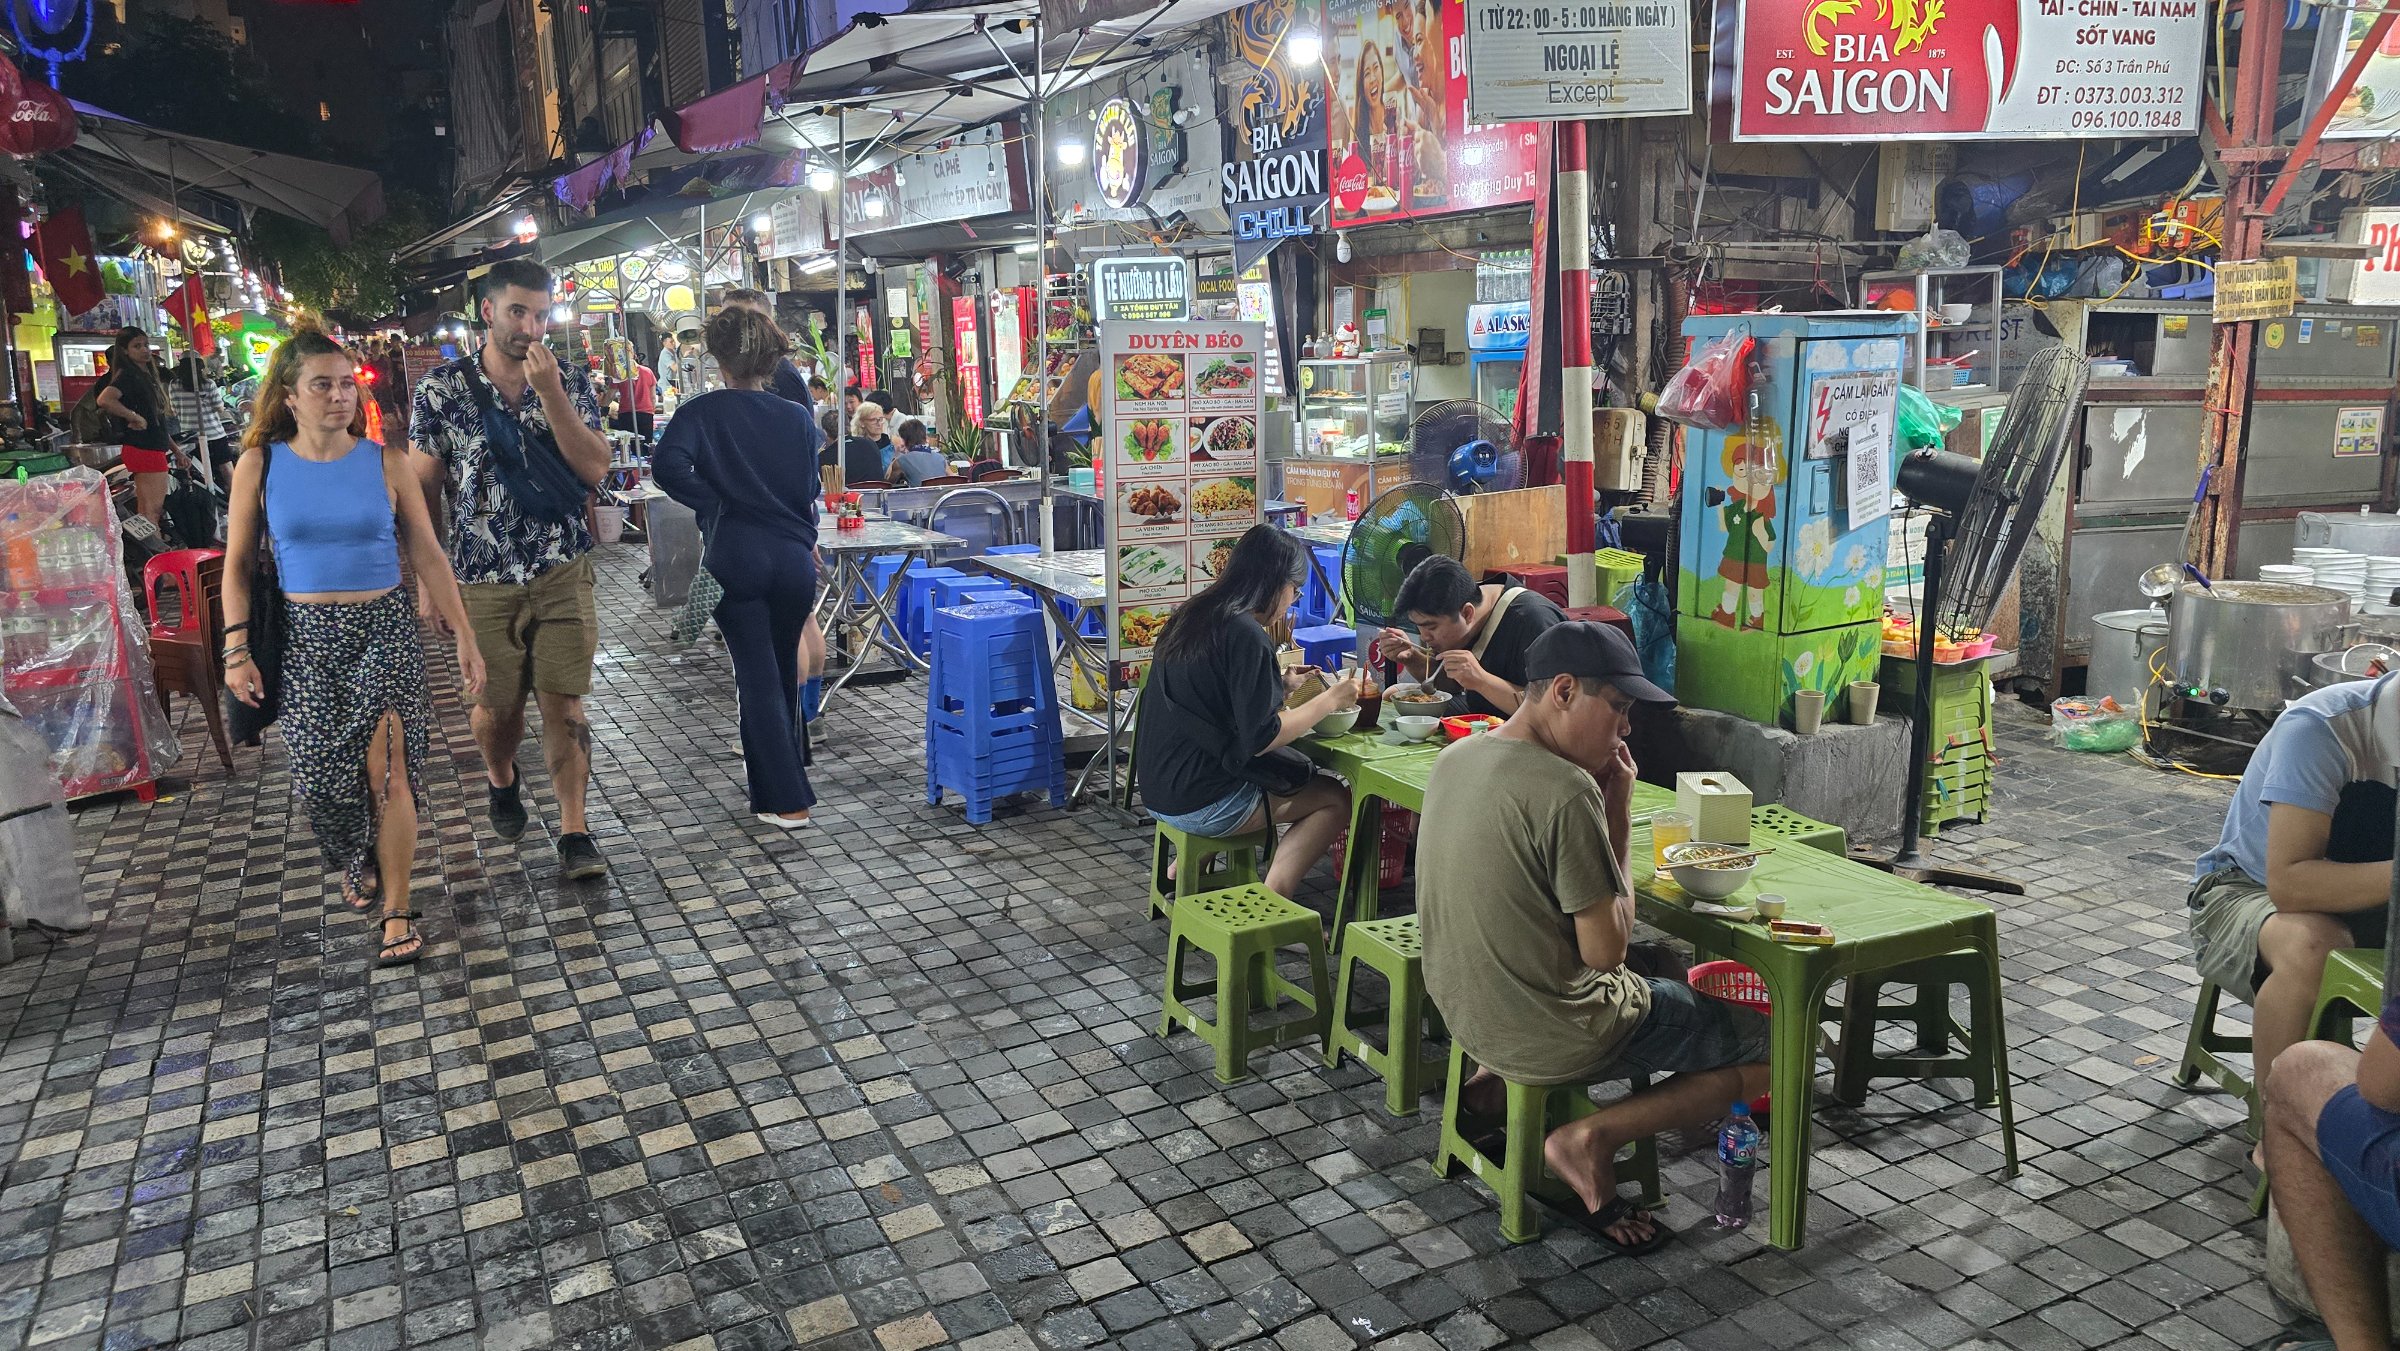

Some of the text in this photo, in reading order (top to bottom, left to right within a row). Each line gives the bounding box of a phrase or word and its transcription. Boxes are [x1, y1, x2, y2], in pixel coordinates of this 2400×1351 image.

[1331, 11, 1346, 25] KHI
[1347, 7, 1358, 18] TA
[1598, 2, 1632, 28] HÀNG
[2160, 2, 2196, 23] NẠM
[2076, 24, 2156, 46] SỐT VANG
[1544, 39, 1620, 76] NGOẠI LỆ
[1775, 48, 1946, 59] EST. 1875
[1832, 34, 1890, 63] BIA
[2086, 58, 2104, 74] Số
[2104, 60, 2112, 73] 3
[2116, 59, 2143, 74] Trần
[2145, 60, 2170, 74] Phú
[1549, 81, 1615, 107] Except
[1765, 67, 1952, 115] SAIGON
[2074, 87, 2184, 105] 0373.003.312
[2071, 110, 2182, 129] 096.100.1848
[1252, 123, 1282, 154] BIA
[1150, 148, 1177, 167] SAIGON
[1221, 149, 1320, 204] SAIGON
[1503, 175, 1523, 193] Duy
[845, 182, 895, 224] SAIN
[1238, 205, 1313, 240] CHILL
[1155, 270, 1164, 300] &
[1198, 280, 1218, 293] LOCAL
[1128, 330, 1244, 349] DUYÊN BÉO
[1845, 408, 1858, 421] CÓ
